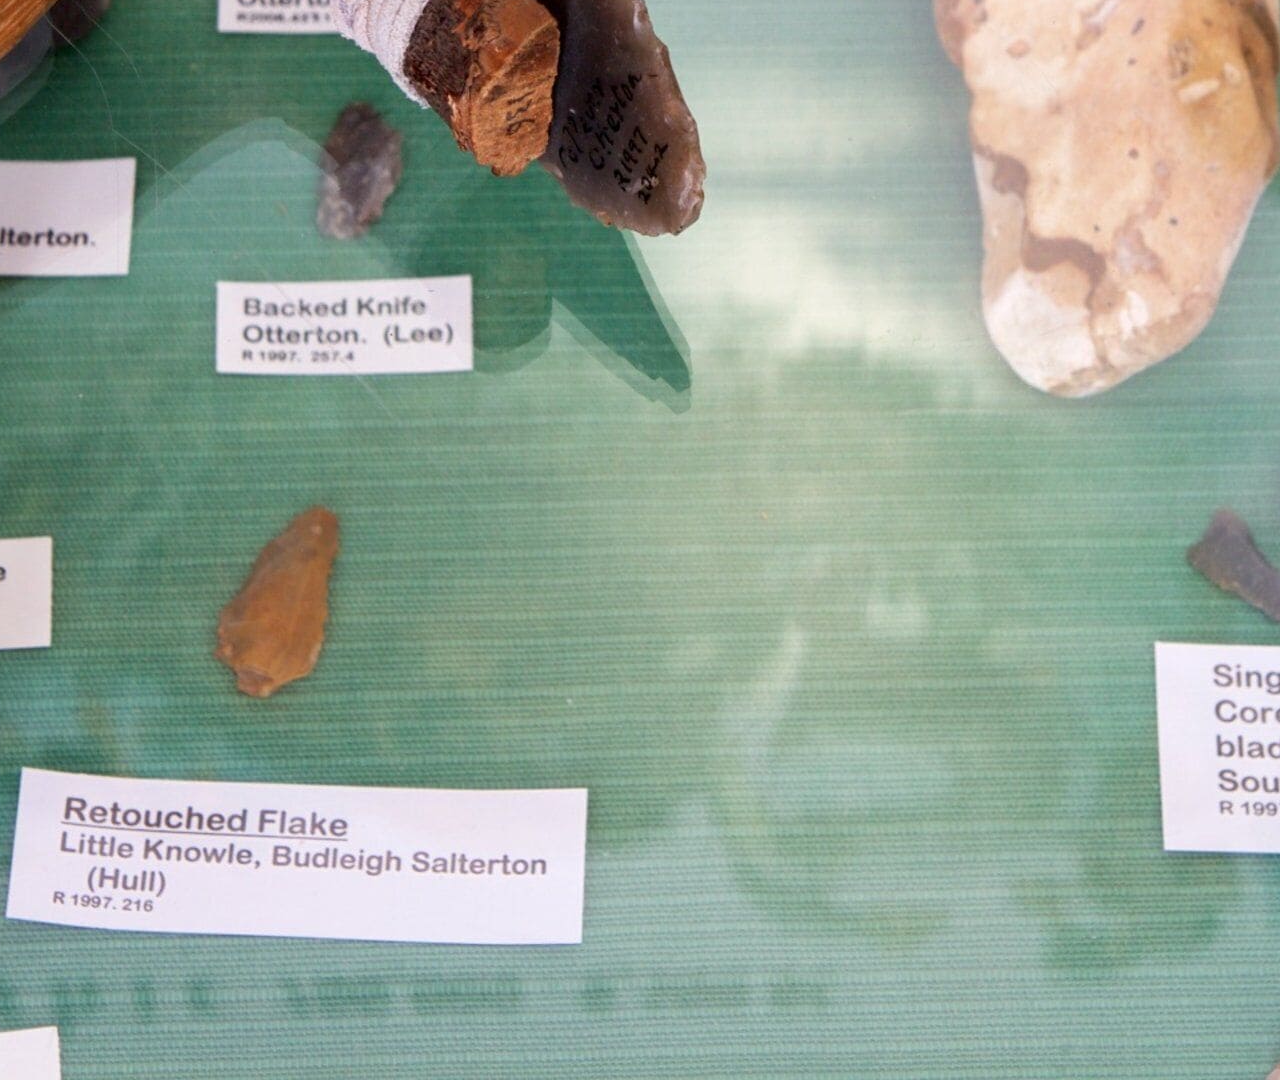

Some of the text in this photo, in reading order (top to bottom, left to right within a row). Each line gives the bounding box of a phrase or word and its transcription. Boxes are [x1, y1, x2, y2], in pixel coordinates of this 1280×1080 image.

[244, 296, 426, 317] Backed Knife
[242, 323, 453, 346] Otterton. (Lee)
[242, 350, 253, 360] R
[64, 796, 348, 838] Retouched Flake
[1219, 800, 1233, 814] R
[61, 831, 547, 877] Little Knowle, Budleigh Salterton
[87, 867, 167, 898] (Hull)
[54, 891, 154, 913] R 1997. 216
